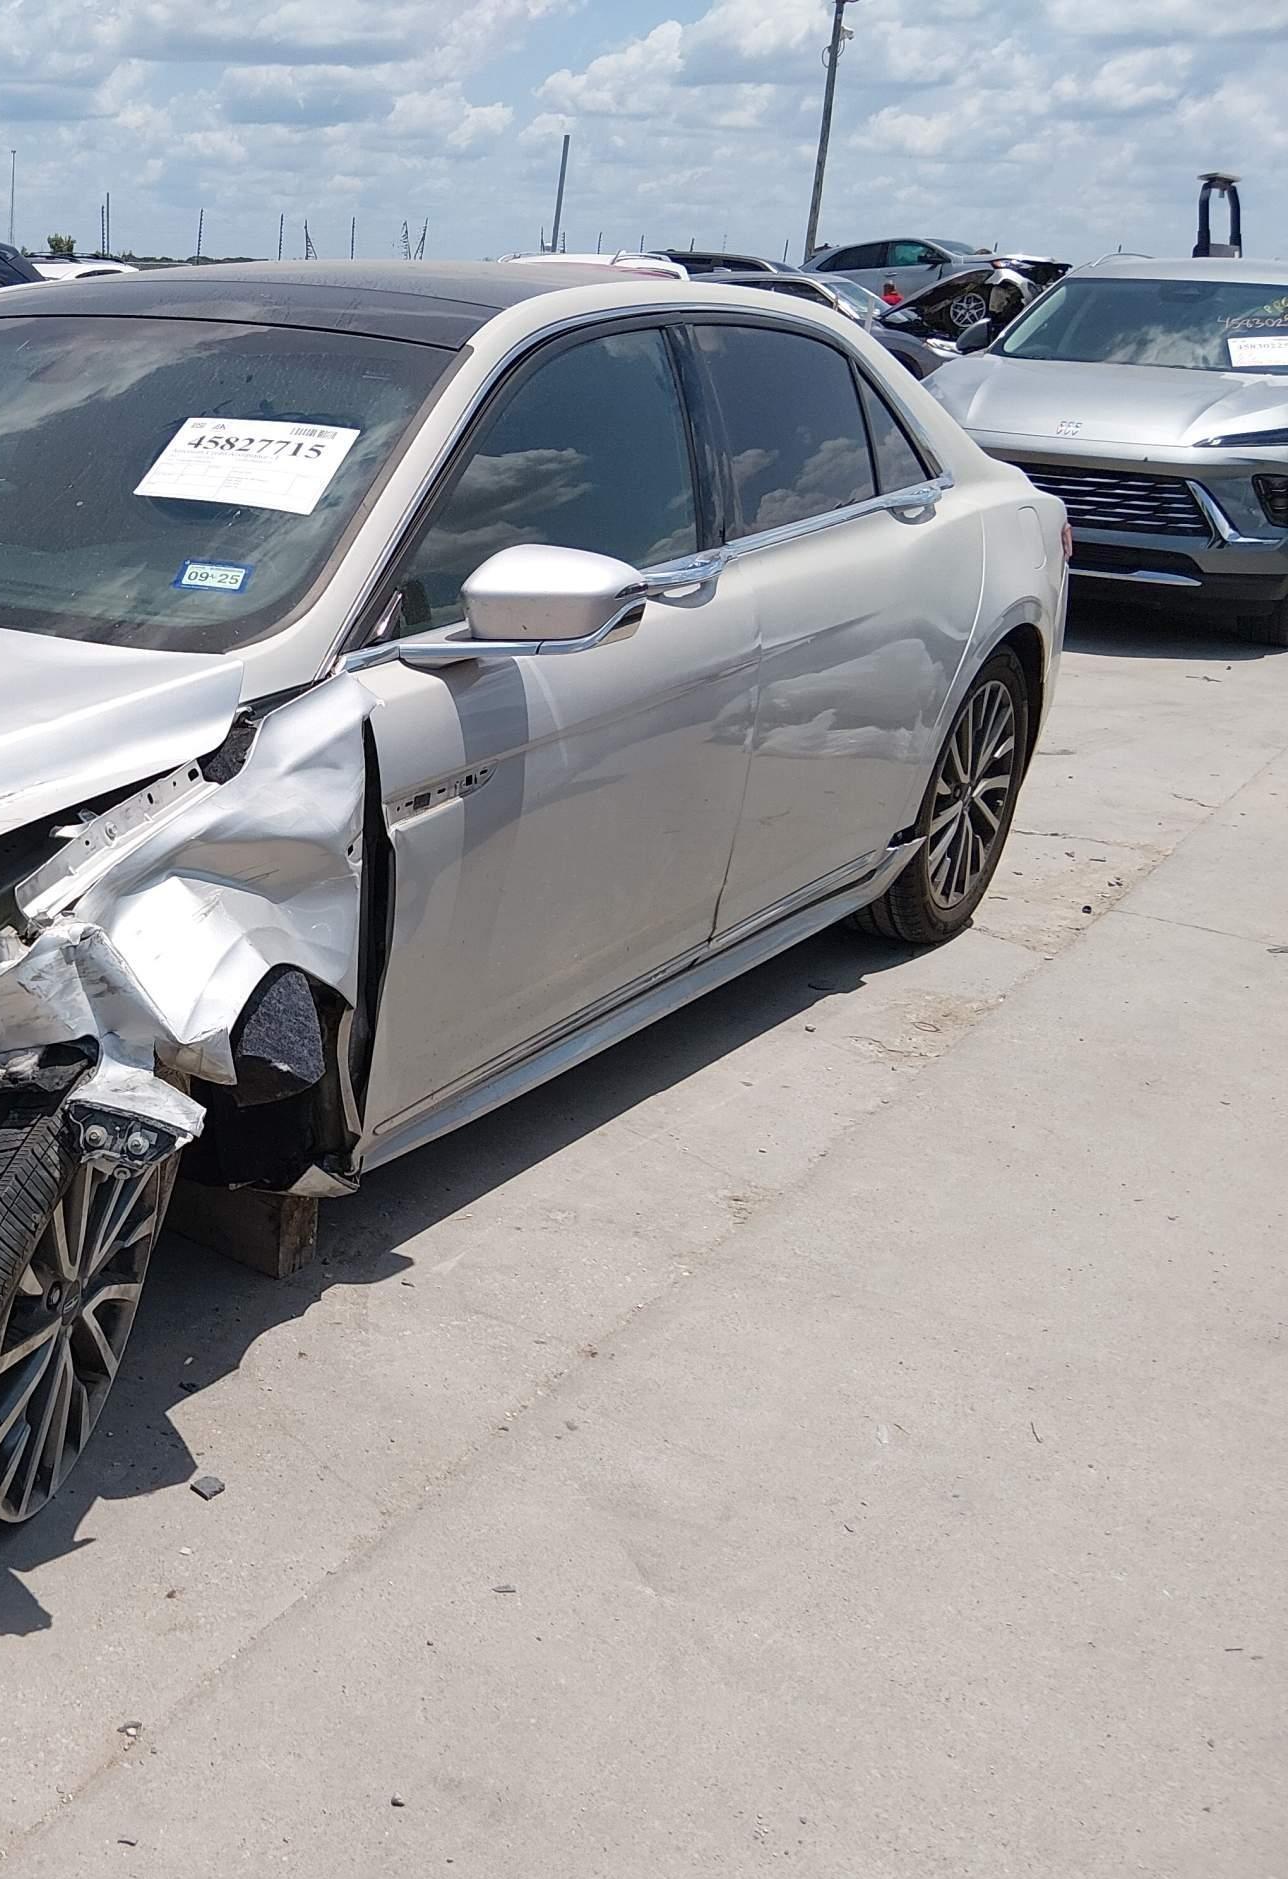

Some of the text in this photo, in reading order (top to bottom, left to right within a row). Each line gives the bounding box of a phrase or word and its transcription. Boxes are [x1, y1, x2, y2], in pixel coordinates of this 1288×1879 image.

[187, 434, 327, 459] 45827715
[187, 570, 241, 585] 09 25
